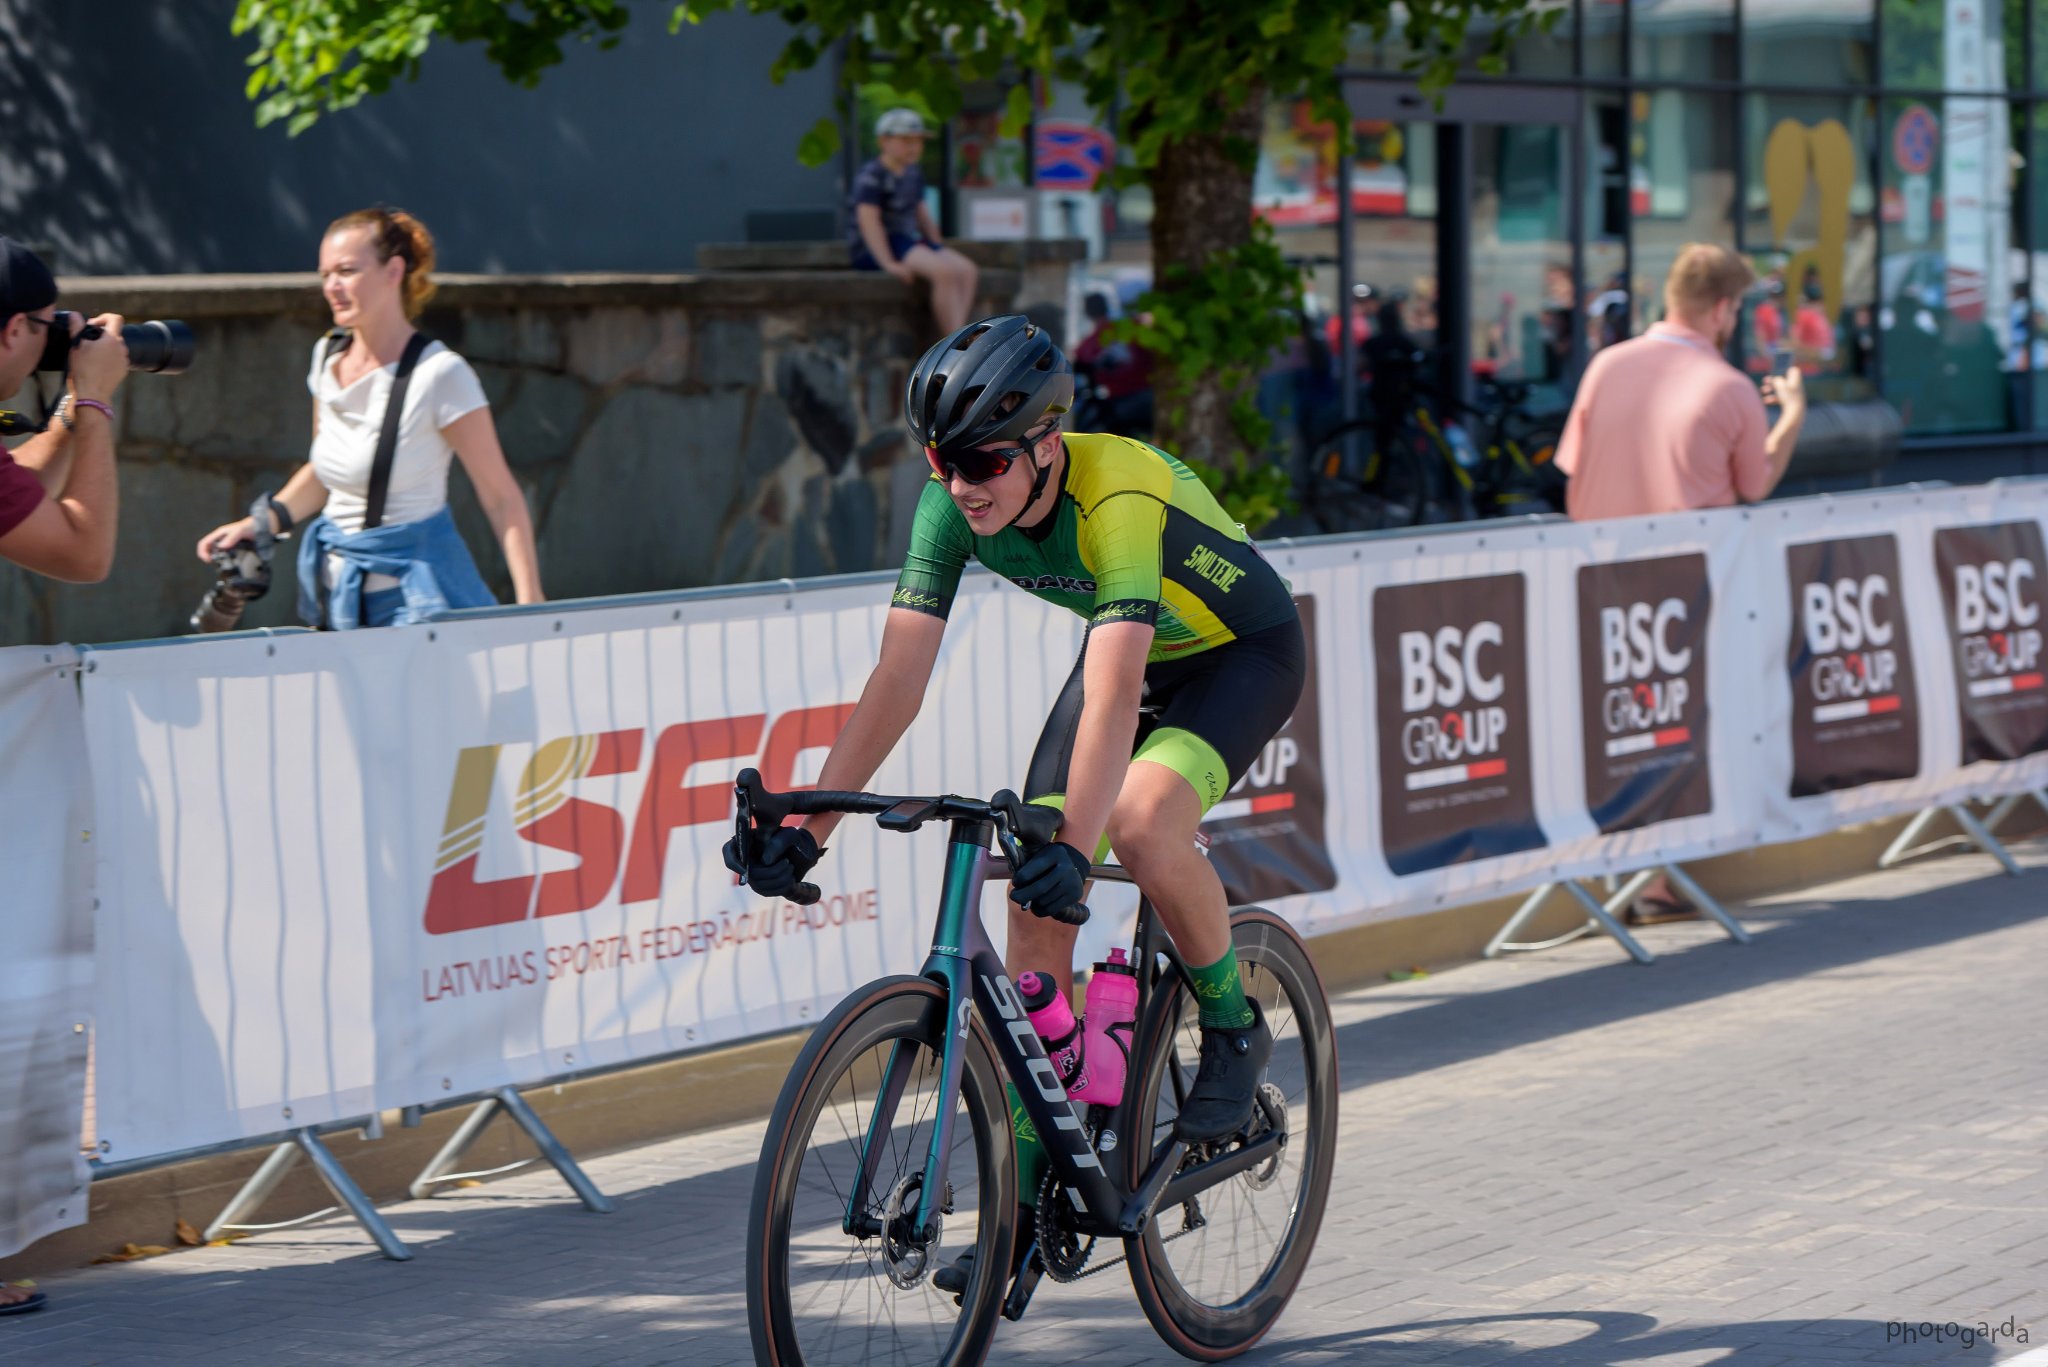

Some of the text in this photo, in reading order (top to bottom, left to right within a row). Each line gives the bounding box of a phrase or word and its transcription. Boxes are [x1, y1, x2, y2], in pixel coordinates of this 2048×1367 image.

[1183, 544, 1246, 593] SMILTENE
[1955, 558, 2039, 633] BSC
[1602, 598, 1692, 684] BSC
[1804, 575, 1893, 653] BSC
[1400, 621, 1504, 713] BSC
[1811, 651, 1897, 701] GROUP
[1961, 629, 2042, 677] GROUP
[1401, 707, 1507, 765] GROUP
[1603, 677, 1690, 733] GROUP
[422, 951, 538, 1002] LATVIJAS
[545, 935, 634, 981] SPORTA
[783, 890, 878, 935] PADOME
[980, 975, 1107, 1179] SCOTT
